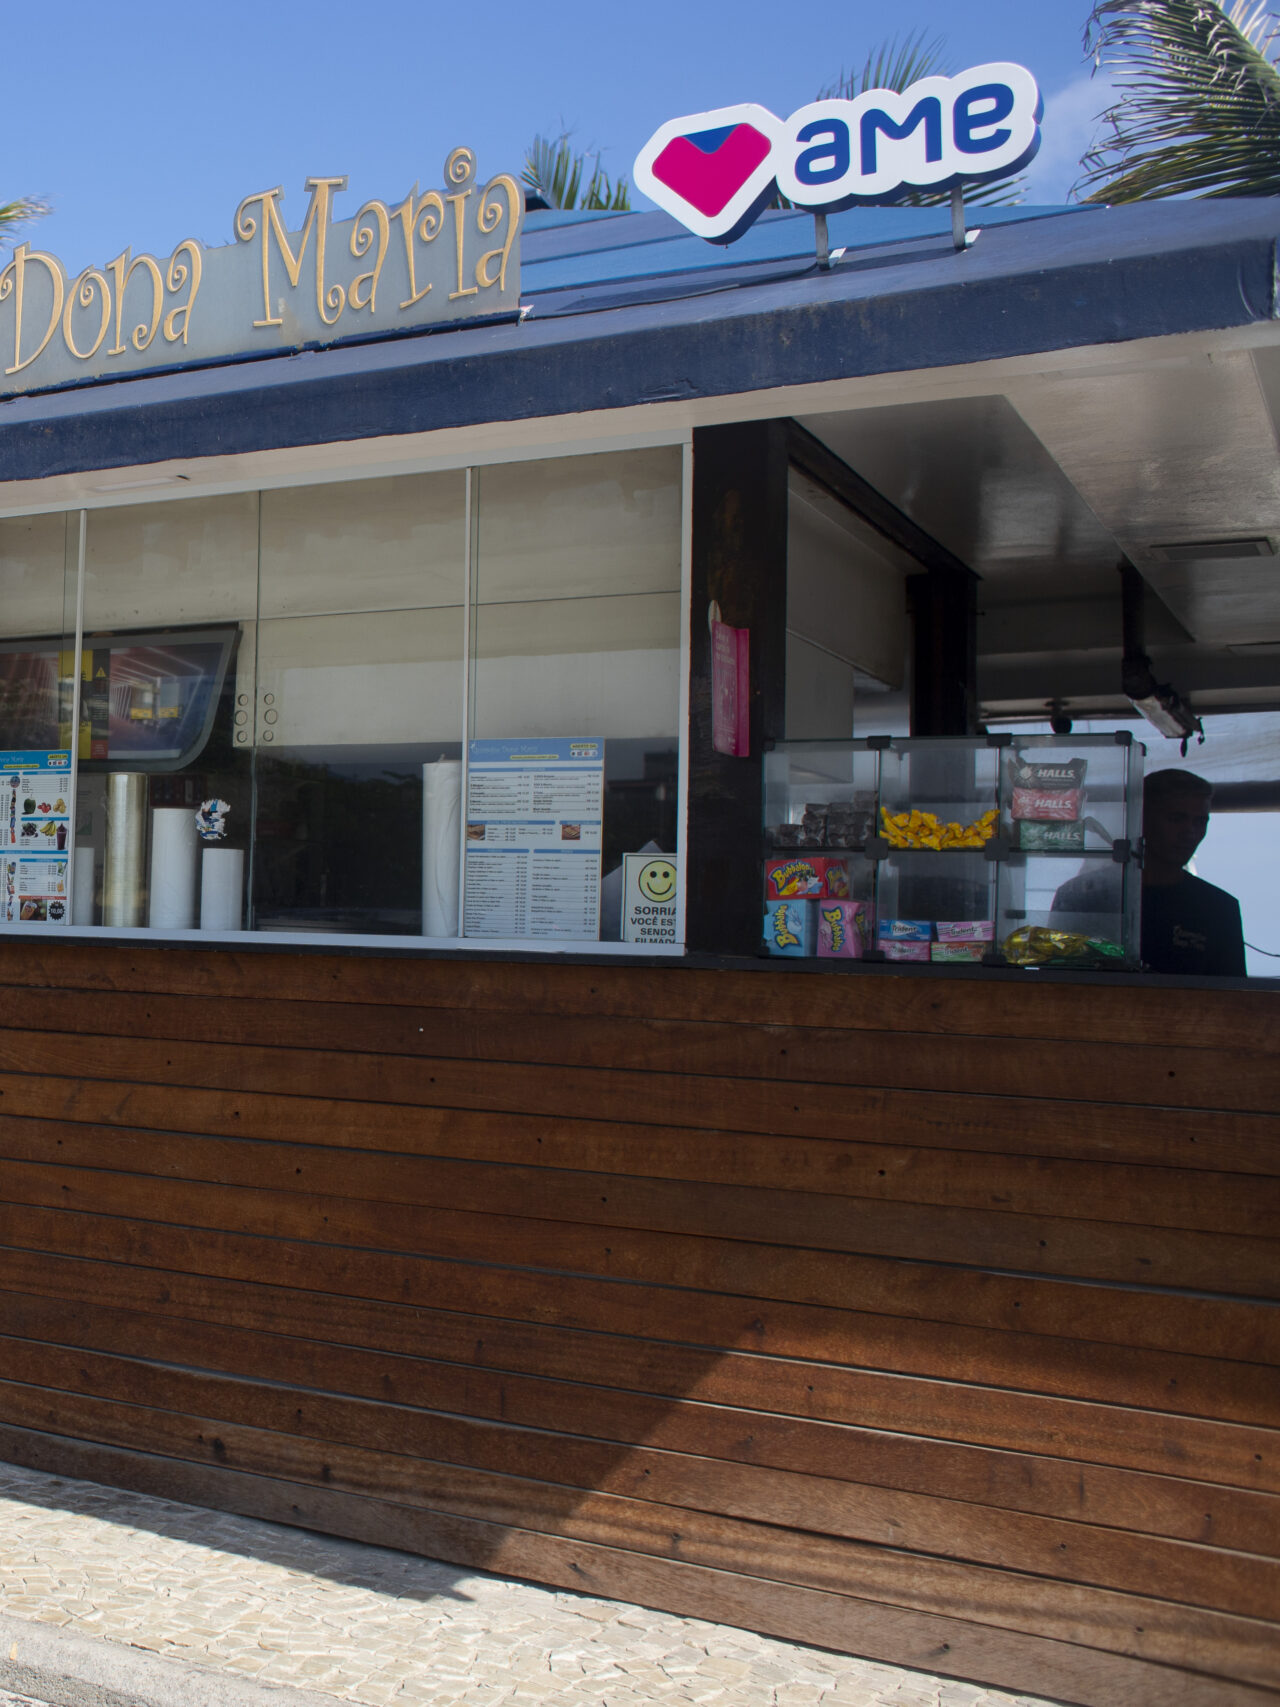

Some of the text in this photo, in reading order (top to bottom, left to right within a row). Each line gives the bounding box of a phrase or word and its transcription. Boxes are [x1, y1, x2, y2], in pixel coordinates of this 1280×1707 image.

[236, 148, 521, 327] Maria
[1037, 768, 1075, 778] HALLS
[1034, 799, 1072, 809] HALLS
[1043, 831, 1080, 841] HALLS
[631, 916, 677, 926] VOCÊ ES
[640, 927, 676, 936] SENDO
[892, 924, 918, 934] Trident
[951, 927, 975, 936] Trident
[944, 946, 969, 956] Trident
